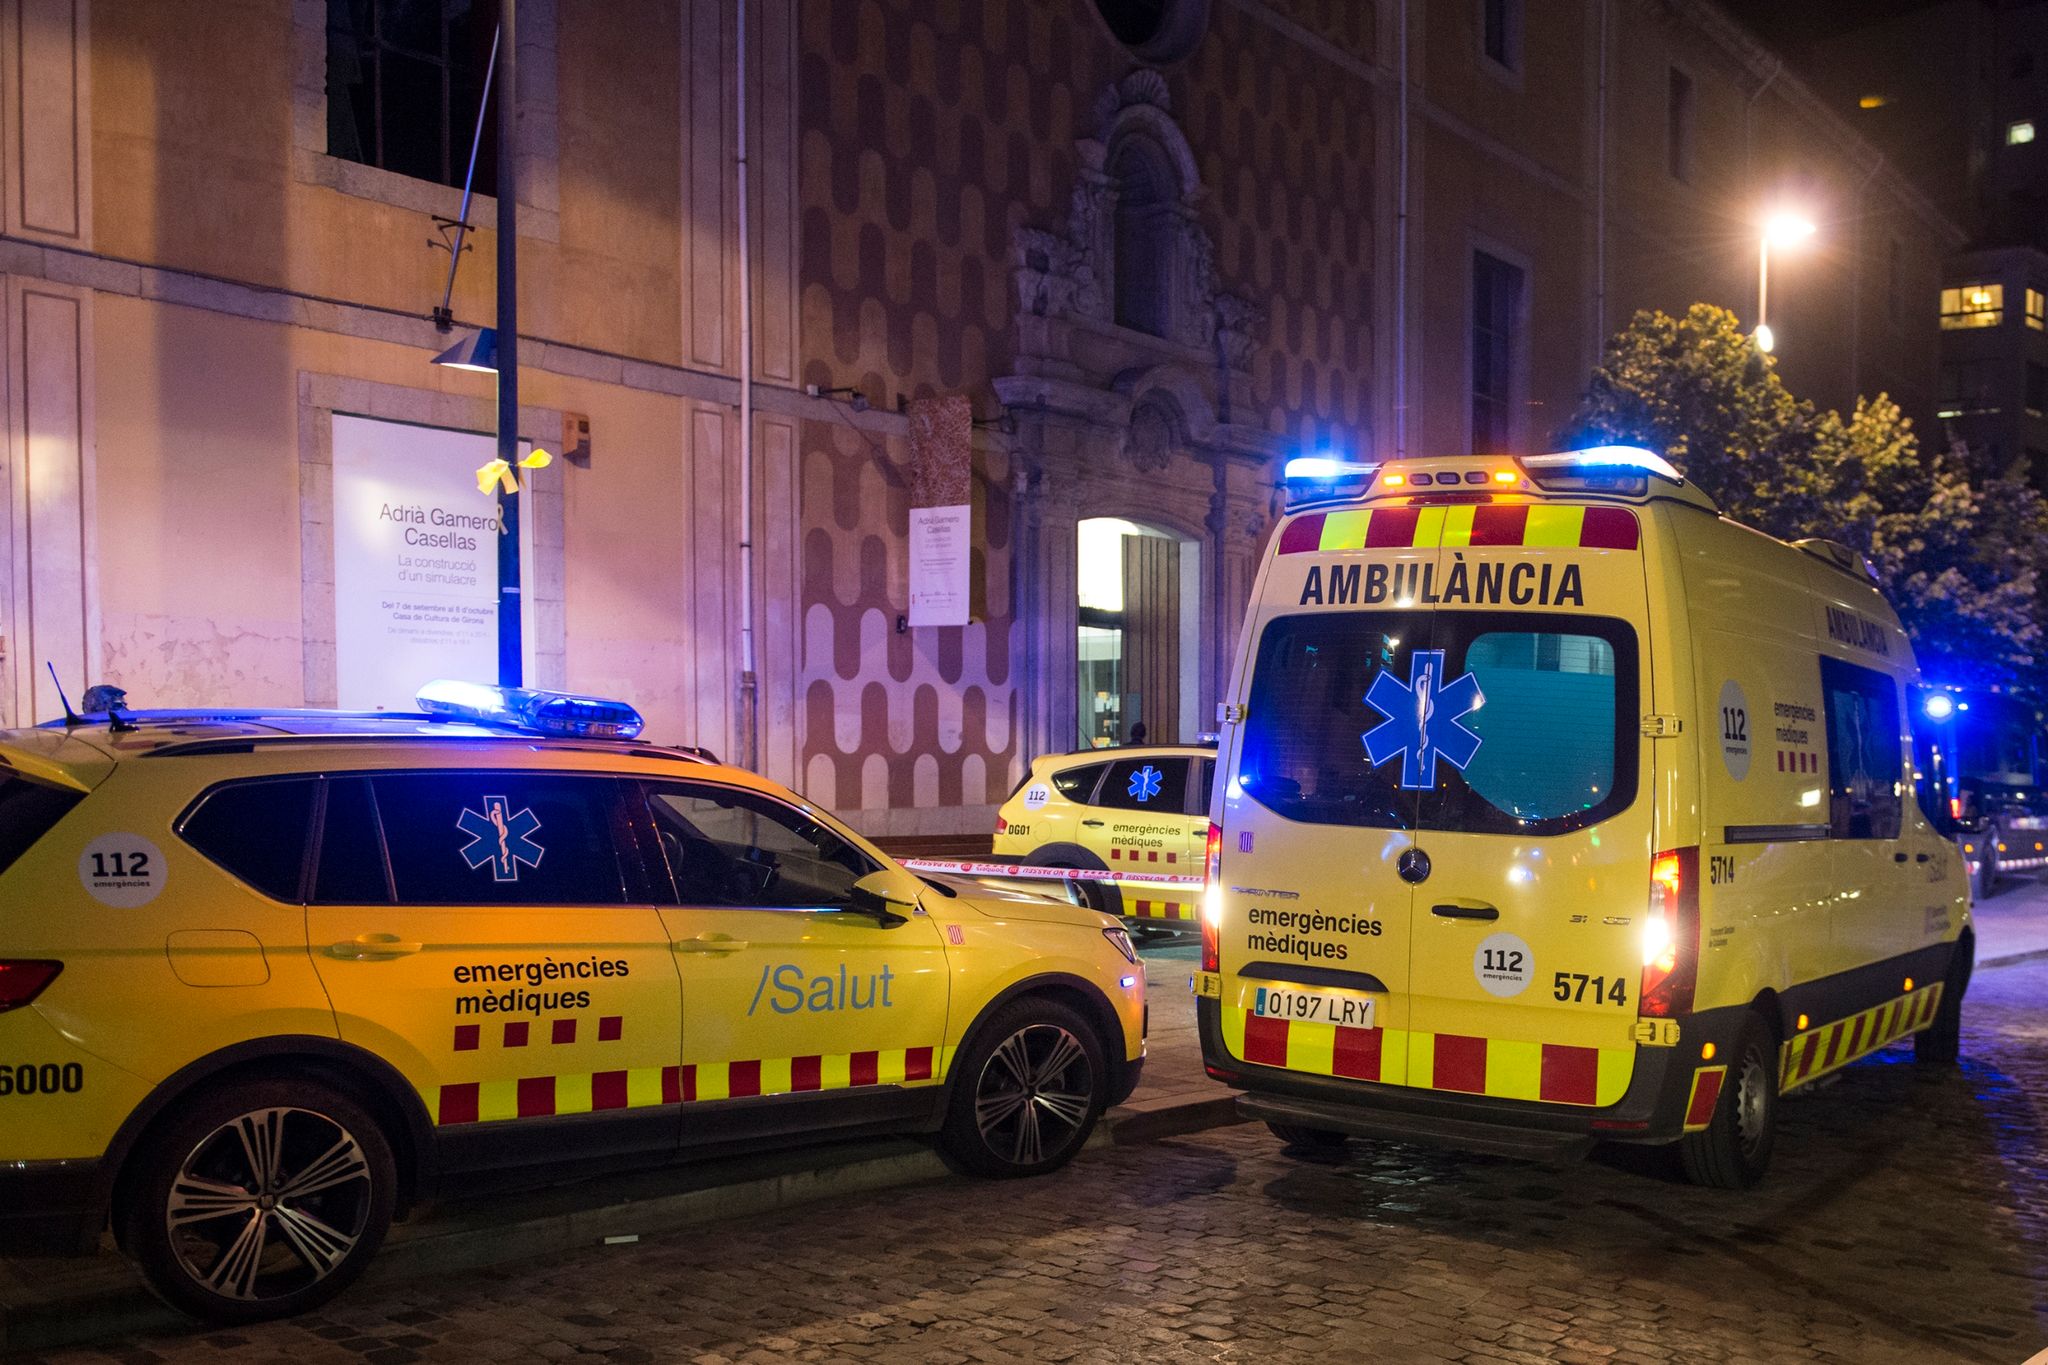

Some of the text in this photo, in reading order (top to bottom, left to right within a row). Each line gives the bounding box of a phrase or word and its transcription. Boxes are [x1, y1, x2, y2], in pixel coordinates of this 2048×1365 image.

[380, 503, 498, 531] Adrià Gamero
[405, 527, 477, 551] Casellas
[398, 554, 477, 572] La construcció
[425, 572, 477, 586] simulacre
[1299, 552, 1584, 606] AMBULÀNCIA
[1723, 706, 1746, 741] 112
[1028, 791, 1045, 801] 112
[1008, 825, 1030, 836] DG01
[1111, 835, 1163, 848] mèdiques
[1113, 823, 1181, 838] emergències
[92, 852, 149, 877] 112
[1710, 855, 1735, 885] 5714
[94, 879, 150, 888] emergències
[1248, 908, 1382, 936] emergències
[1247, 931, 1348, 961] mèdiques
[454, 955, 630, 986] emergències
[1483, 949, 1523, 973] 112
[1483, 973, 1523, 982] emergències
[1553, 971, 1627, 1007] 5714
[456, 989, 590, 1016] mèdiques
[1269, 992, 1370, 1025] 0197 LRY
[0, 1062, 83, 1096] 6000
